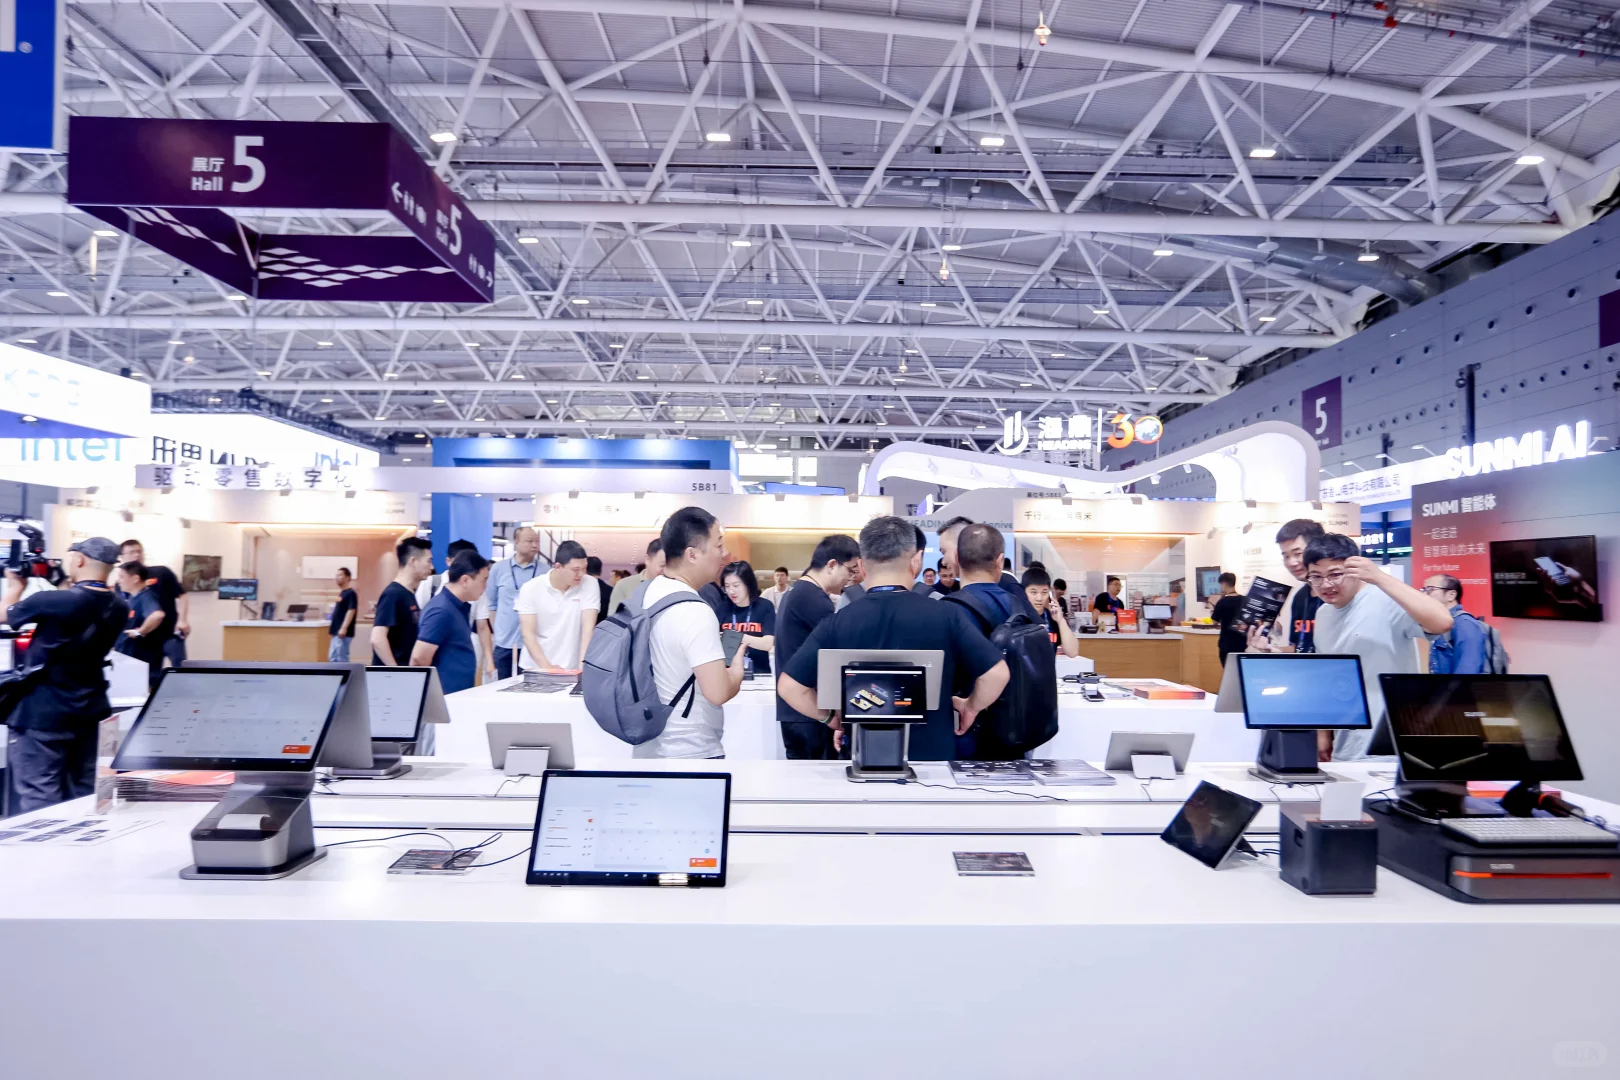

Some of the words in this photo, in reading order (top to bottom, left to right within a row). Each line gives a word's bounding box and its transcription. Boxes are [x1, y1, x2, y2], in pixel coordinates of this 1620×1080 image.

[191, 156, 225, 172] 展厅
[231, 135, 266, 192] 5
[191, 176, 223, 191] Hall
[449, 204, 462, 255] 5
[1315, 396, 1328, 435] 5
[691, 482, 717, 491] 5B81
[1422, 499, 1459, 517] SUNMI
[1460, 493, 1497, 514] 智能体
[1423, 526, 1458, 540] 一起走进
[1423, 542, 1487, 558] 智慧商业的未来
